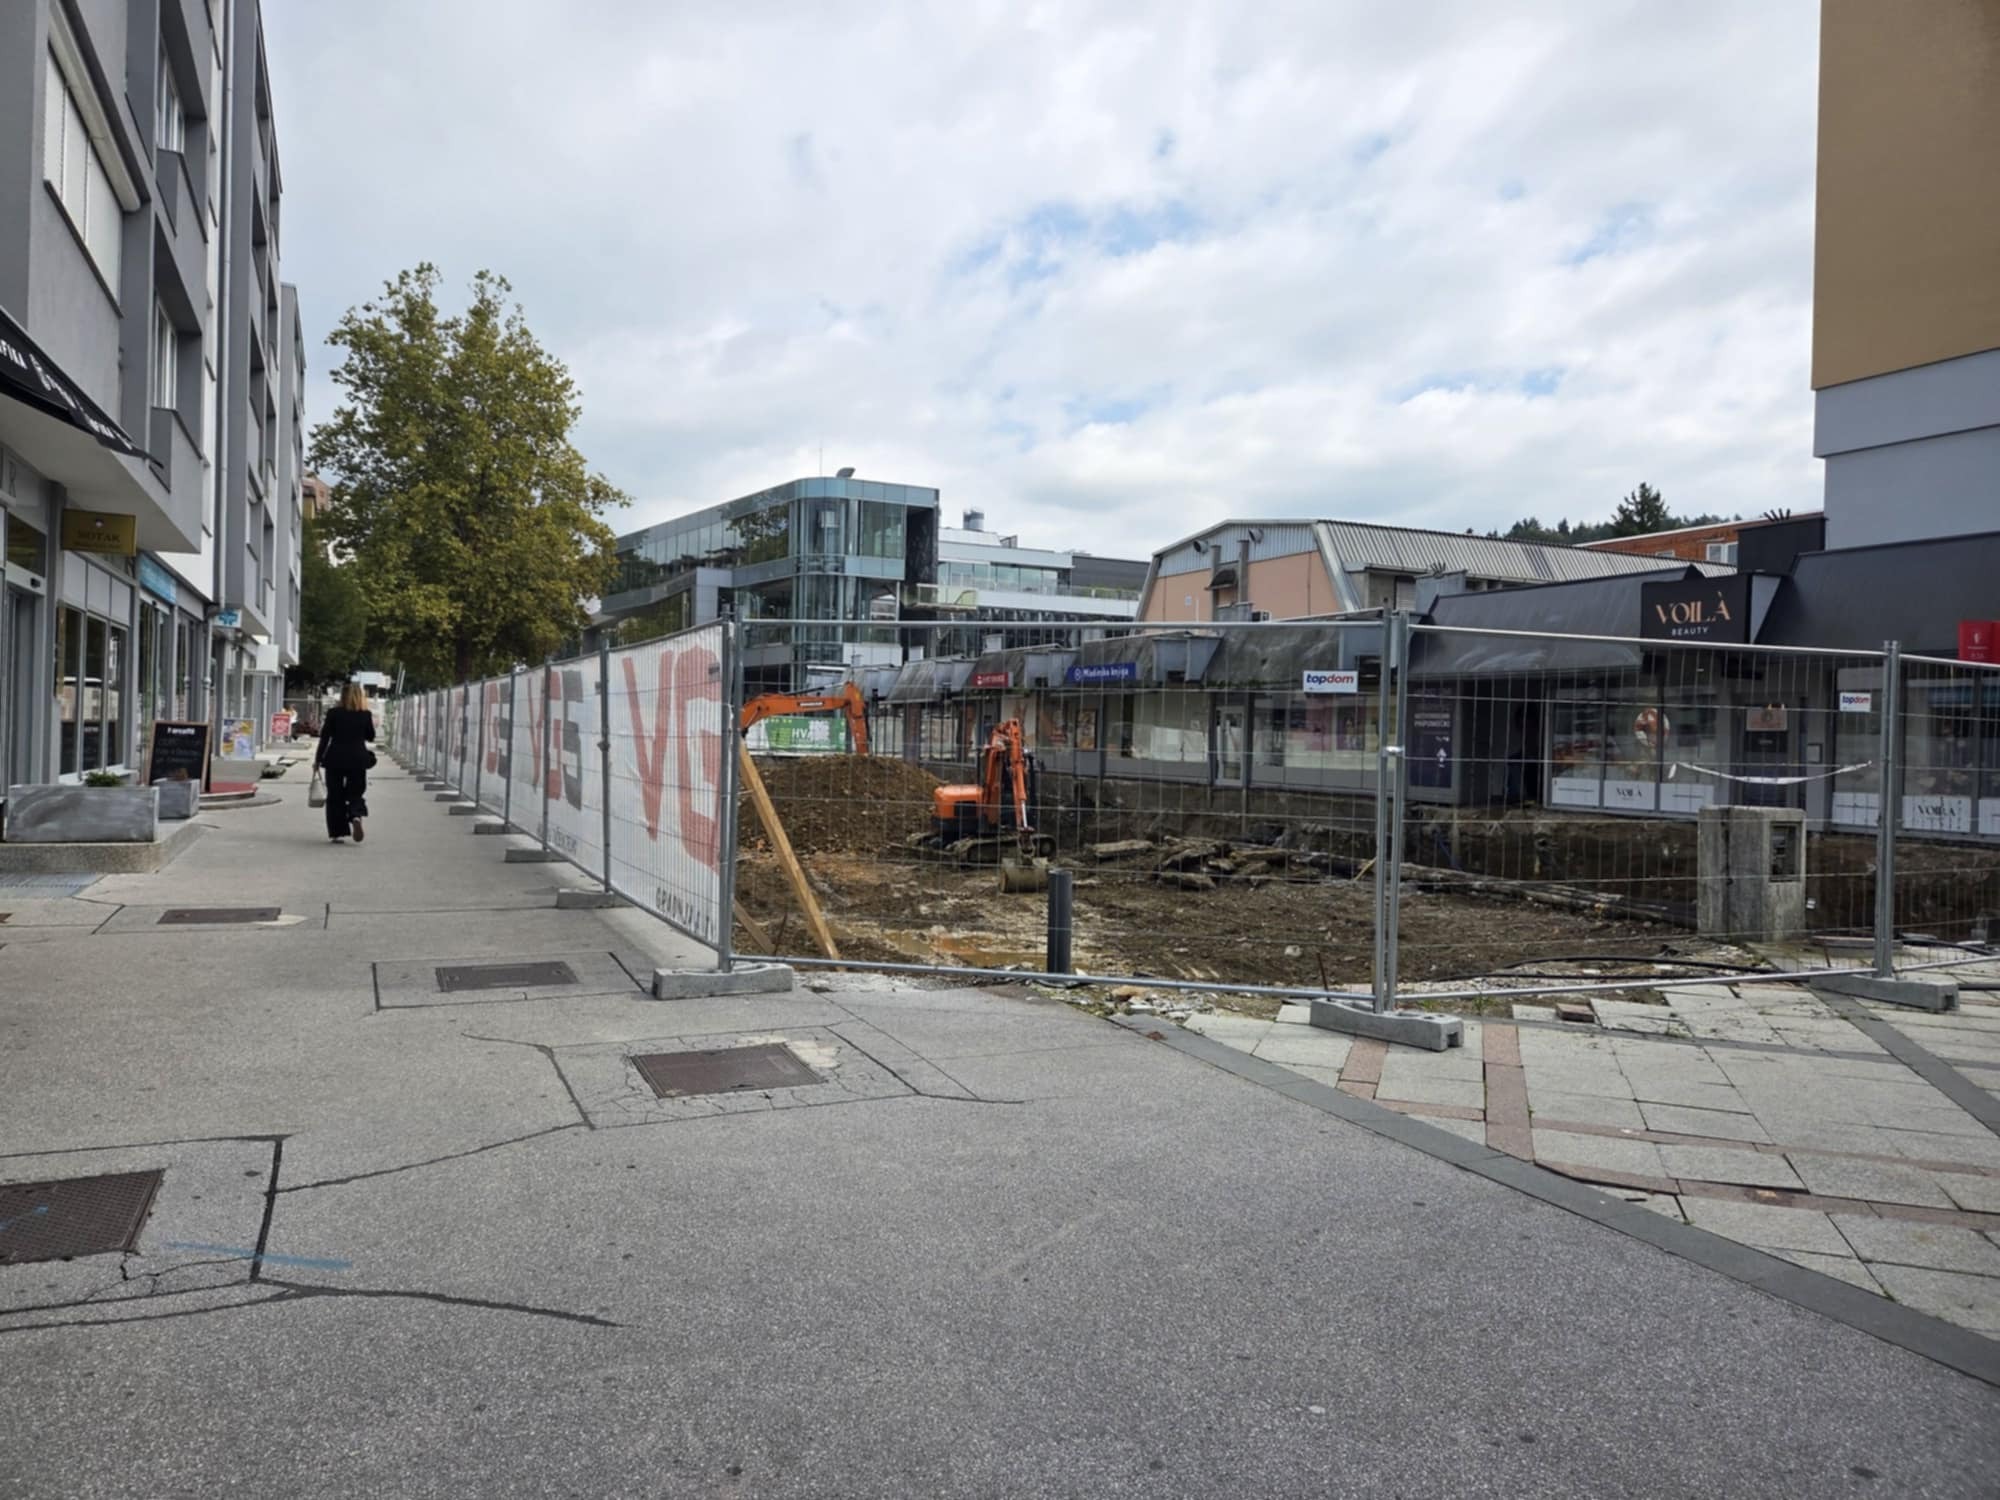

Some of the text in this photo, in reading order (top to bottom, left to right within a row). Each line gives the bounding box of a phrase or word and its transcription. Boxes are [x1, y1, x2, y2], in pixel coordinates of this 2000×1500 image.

[1671, 626, 1709, 636] BEAUTY
[1306, 673, 1354, 685] topdom
[1842, 694, 1870, 705] topdom
